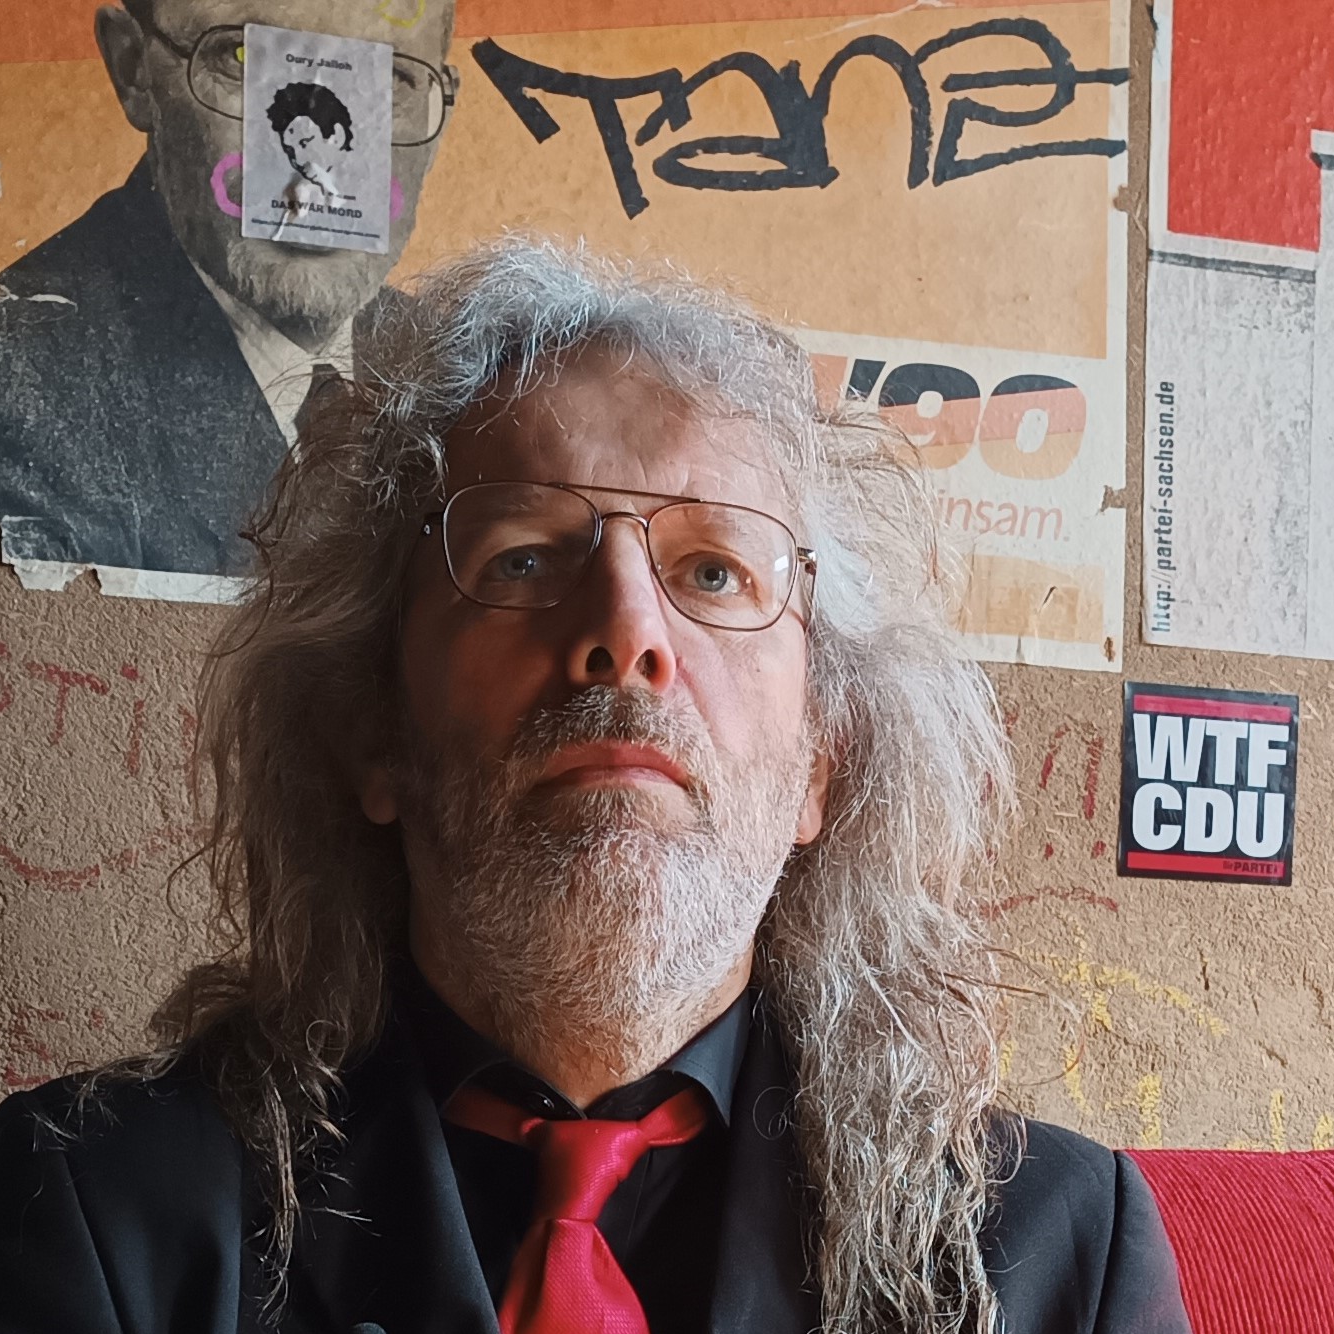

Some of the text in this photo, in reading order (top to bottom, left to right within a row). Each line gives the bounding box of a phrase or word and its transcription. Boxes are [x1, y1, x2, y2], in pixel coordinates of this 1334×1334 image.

[285, 53, 353, 71] Oury Jalloh
[327, 205, 363, 219] MORD
[1150, 380, 1178, 633] http://partei-sachsen.de
[1132, 713, 1290, 788] WTF
[1132, 782, 1285, 858] CDU
